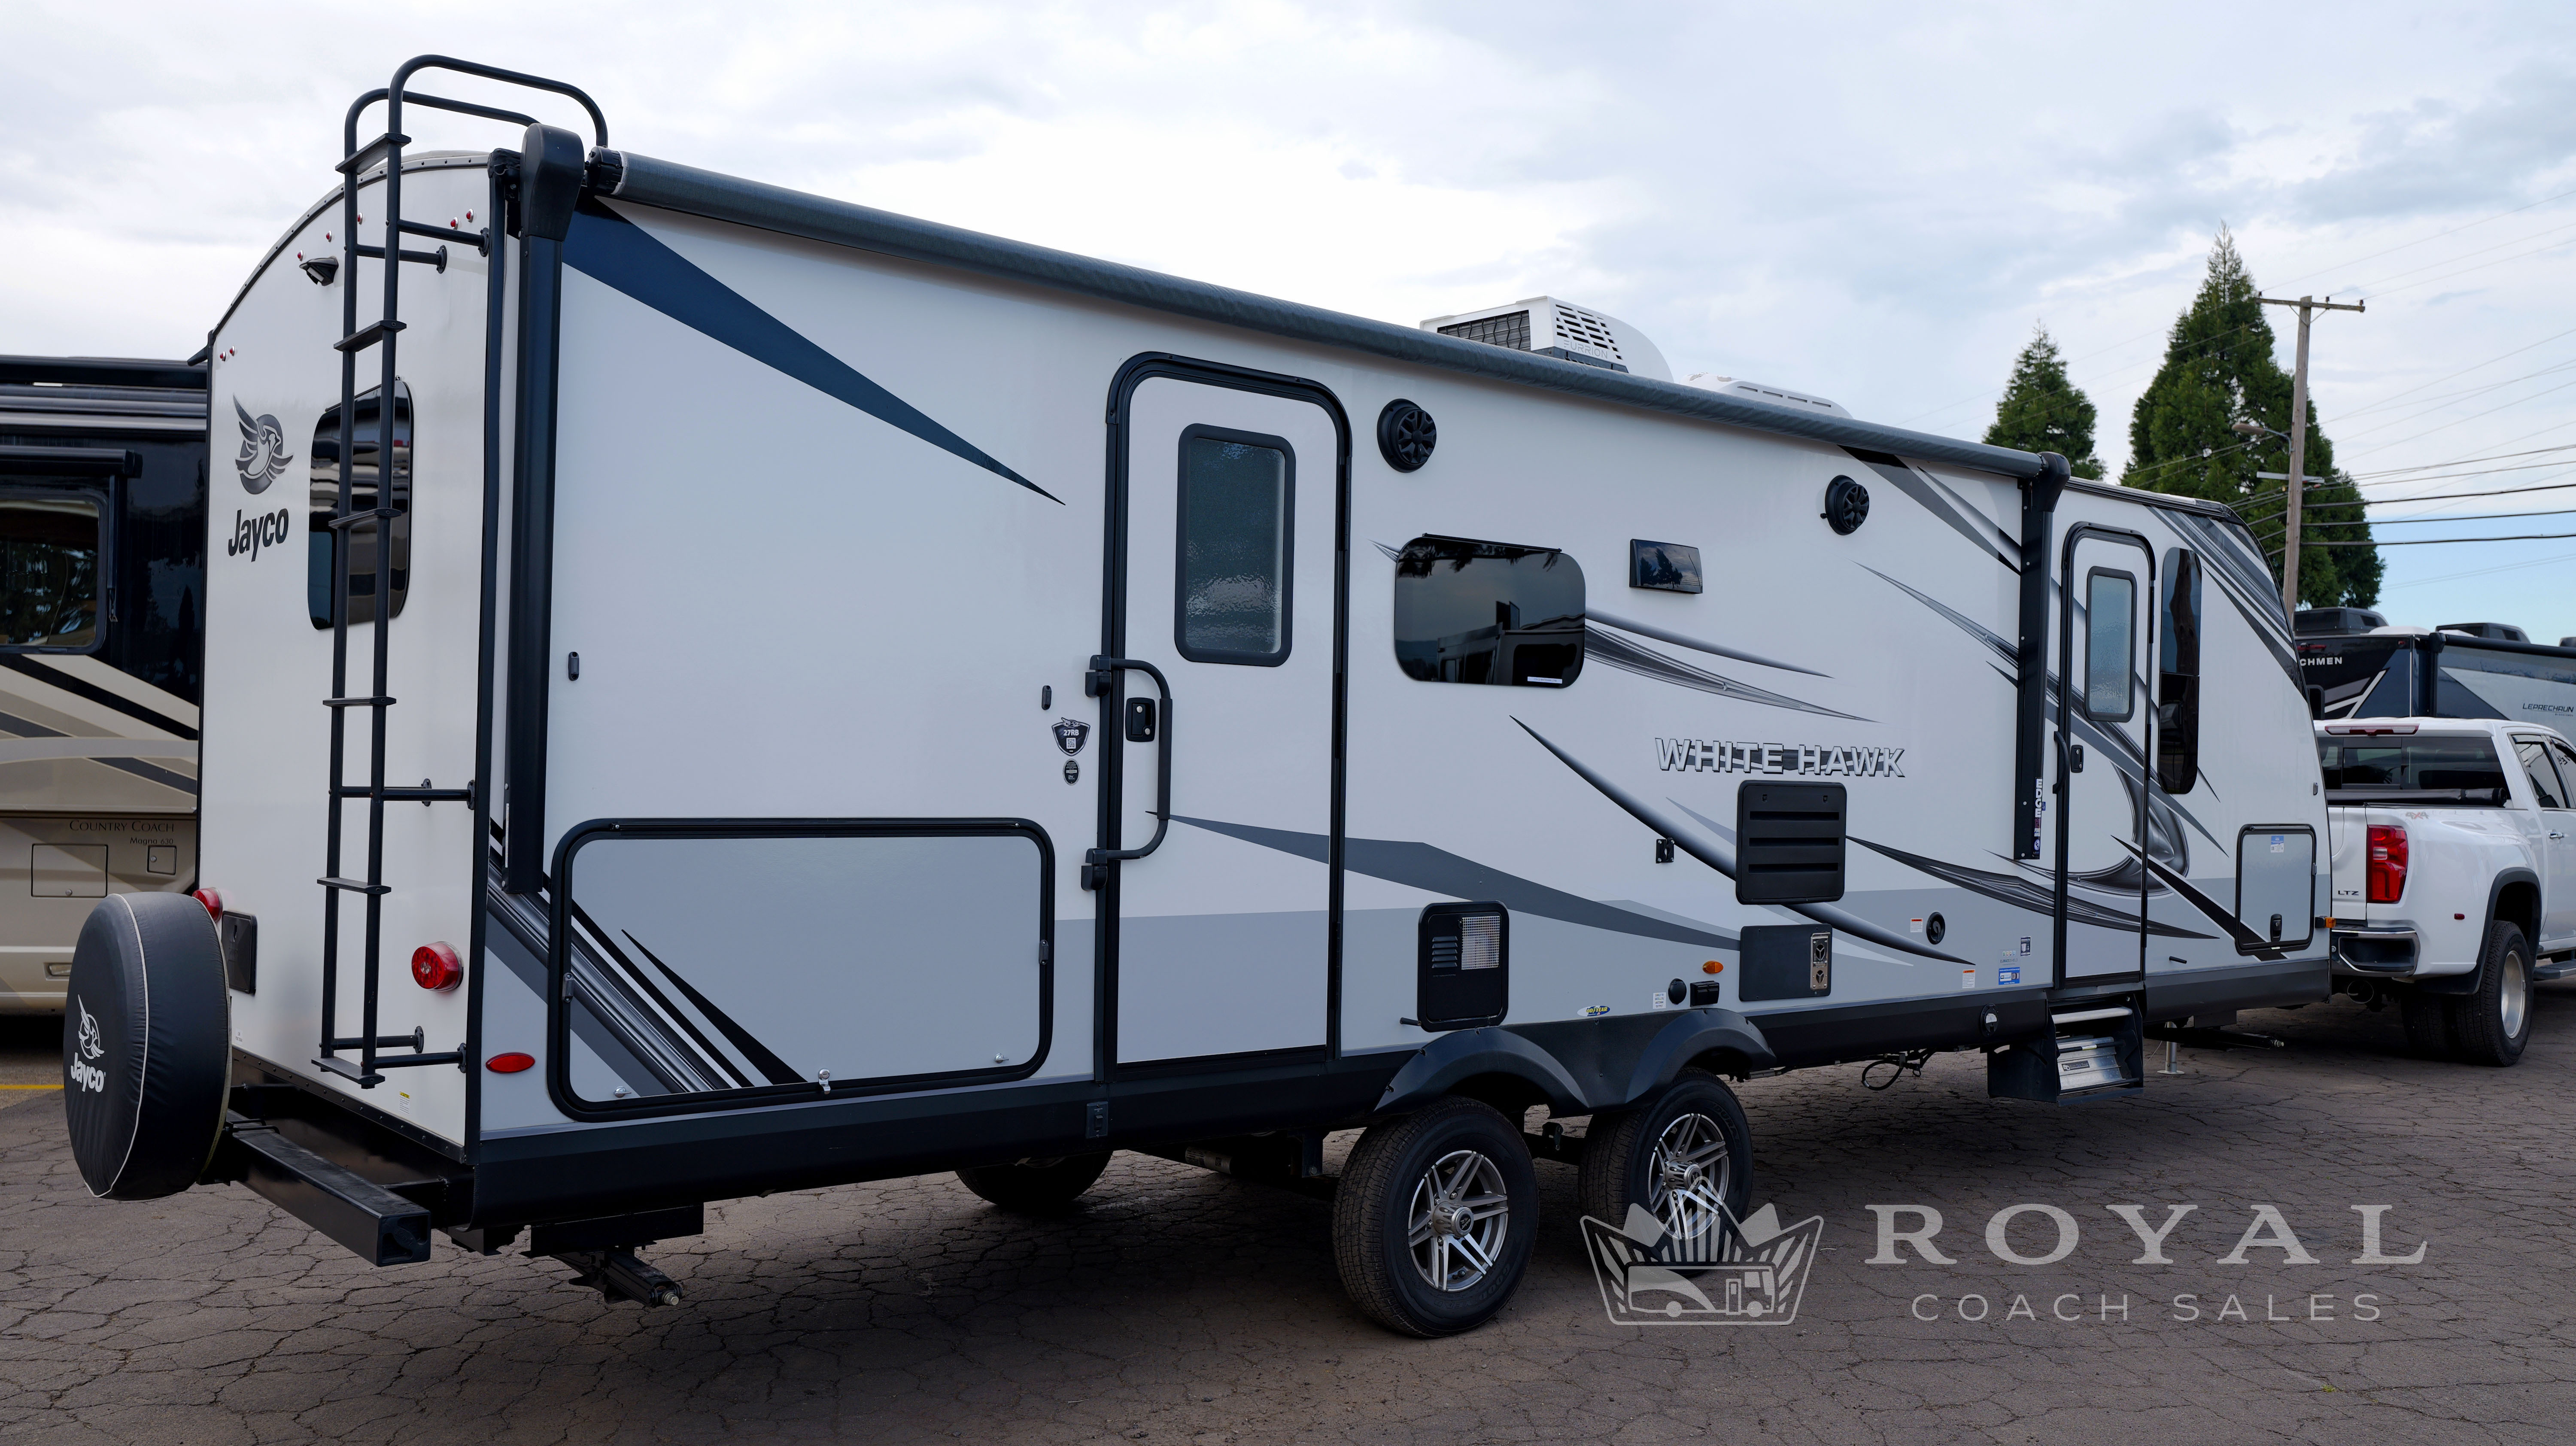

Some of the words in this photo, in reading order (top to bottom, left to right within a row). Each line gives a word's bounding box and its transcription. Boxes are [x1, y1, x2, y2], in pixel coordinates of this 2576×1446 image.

[1564, 339, 1607, 359] FURRION
[228, 508, 289, 562] Jayco
[2522, 703, 2574, 713] LEPRECHAUN
[1655, 737, 1784, 775] WHITE
[1797, 743, 1906, 778] HAWK
[69, 819, 128, 832] COUNTRY
[131, 820, 174, 832] COACH
[130, 836, 158, 846] Magna
[70, 1052, 104, 1093] Jayco
